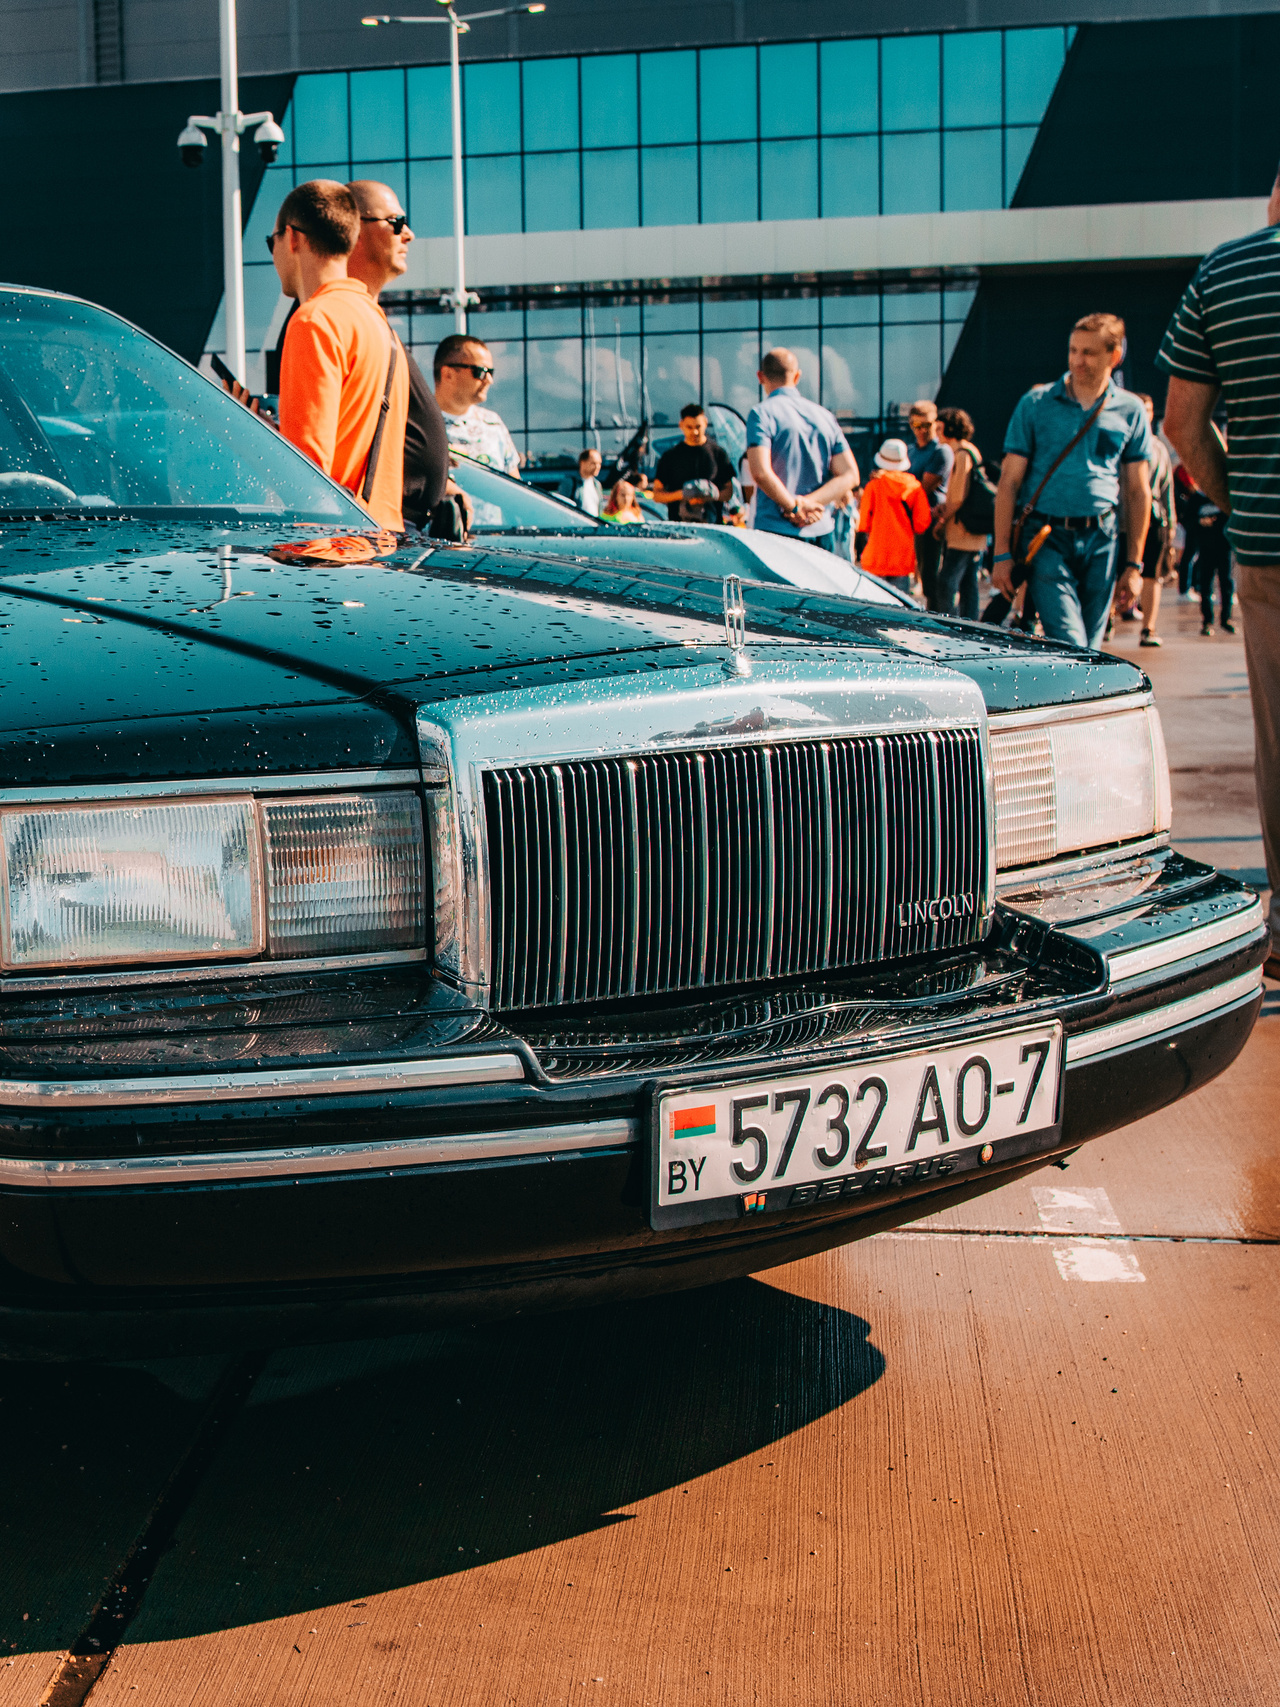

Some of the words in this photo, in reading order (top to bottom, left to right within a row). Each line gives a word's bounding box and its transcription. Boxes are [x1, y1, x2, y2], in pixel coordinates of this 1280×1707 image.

[898, 892, 974, 927] LINCOLN
[731, 1074, 890, 1185] 5732
[667, 1156, 707, 1195] BY
[788, 1153, 960, 1207] BELARUS
